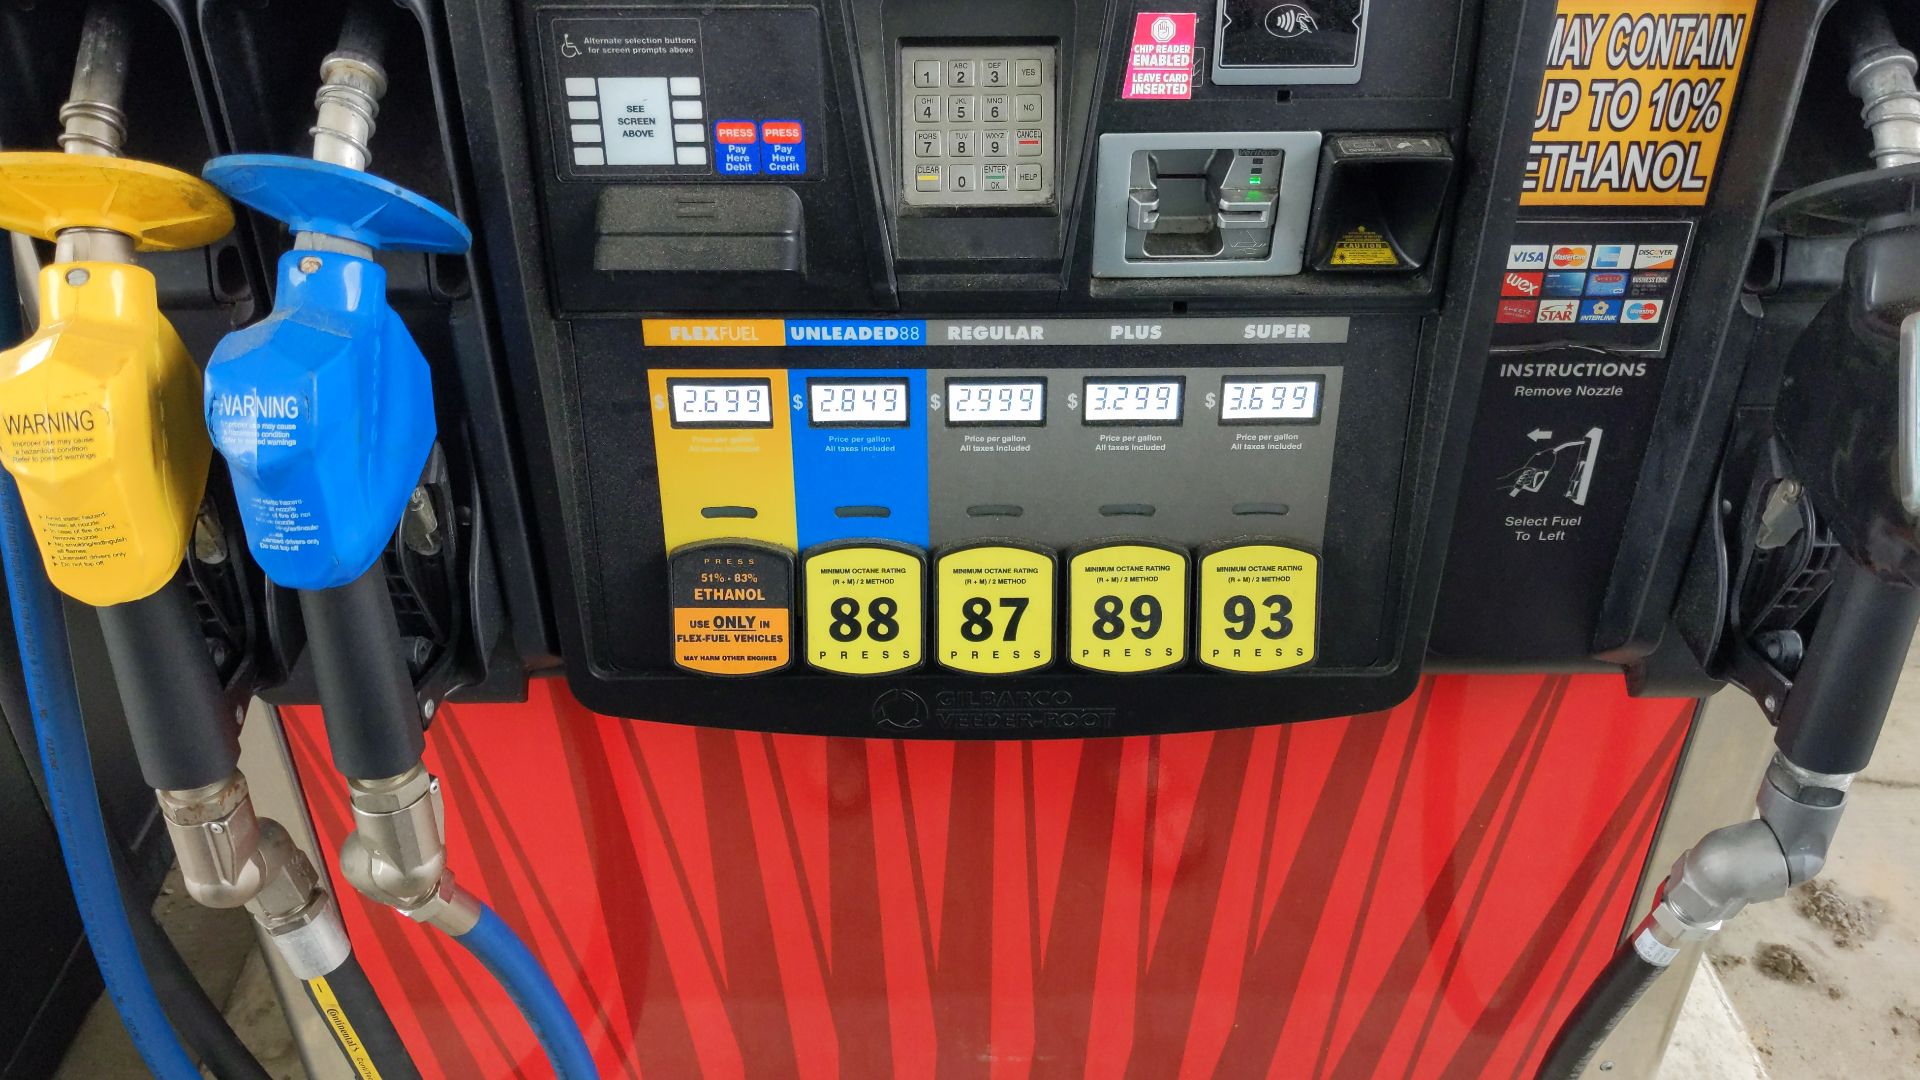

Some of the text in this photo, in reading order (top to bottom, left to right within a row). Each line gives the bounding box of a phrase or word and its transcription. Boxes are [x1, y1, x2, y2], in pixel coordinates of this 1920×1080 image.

[584, 37, 697, 45] Alternate selection buttons
[1606, 13, 1746, 70] CONTAIN
[632, 47, 667, 55] prompts
[1134, 44, 1191, 54] CHIP READER
[1133, 54, 1190, 67] ENABLED
[923, 72, 931, 84] 1
[957, 72, 965, 83] 2
[991, 72, 999, 83] 3
[1132, 73, 1189, 83] LEAVE CARD
[1131, 83, 1188, 96] INSERTED
[626, 105, 645, 113] SEE
[1588, 78, 1641, 131] TO
[1649, 78, 1725, 133] 10%
[923, 107, 931, 118] 4
[957, 107, 965, 118] 5
[991, 107, 999, 118] 6
[617, 117, 656, 126] SCREEN
[622, 130, 654, 138] ABOVE
[718, 128, 754, 137] PRESS
[764, 128, 799, 137] PRESS
[728, 145, 746, 155] Pay
[774, 145, 792, 155] Pay
[924, 142, 932, 153] 7
[958, 142, 966, 153] 8
[991, 142, 999, 153] 9
[726, 154, 750, 162] Here
[772, 154, 796, 162] Here
[725, 163, 753, 171] Debit
[769, 163, 800, 171] Credit
[1521, 141, 1708, 192] ETHANOL
[958, 176, 966, 187] 0
[1019, 173, 1038, 181] HELP
[1513, 251, 1544, 263] VISA
[1539, 310, 1572, 321] STAR
[670, 326, 759, 341] FLEXFUEL
[790, 326, 920, 340] UNLEADED88
[947, 326, 1044, 340] REGULAR
[1110, 325, 1162, 340] PLUS
[1243, 324, 1311, 339] SUPER
[1500, 363, 1647, 377] INSTRUCTIONS
[1514, 385, 1623, 397] Remove Nozzle
[654, 389, 761, 413] $ 2.699
[793, 388, 898, 412] $ 2.849
[930, 388, 1033, 412] $ 2.999
[1067, 386, 1171, 411] $ 3.299
[1205, 386, 1308, 410] $ 3.699
[3, 409, 95, 435] WARNING
[866, 436, 890, 444] gallon
[1002, 436, 1026, 444] gallon
[1137, 435, 1162, 443] gallon
[1274, 434, 1299, 442] gallon
[1505, 517, 1582, 526] Select Fuel
[1515, 531, 1565, 541] To Left
[701, 573, 758, 583] 51% 83%
[694, 588, 765, 601] ETHANOL
[690, 616, 770, 629] USE ONLY IN
[829, 597, 900, 642] 88
[961, 597, 1030, 642] 87
[1092, 595, 1162, 640] 89
[1223, 594, 1294, 640] 93
[677, 635, 783, 643] FLEX-FUEL VEHICLES
[936, 690, 1073, 706] GILBARCO
[936, 712, 1115, 727] VEEDER-ROOT
[326, 1008, 356, 1048] Continental
